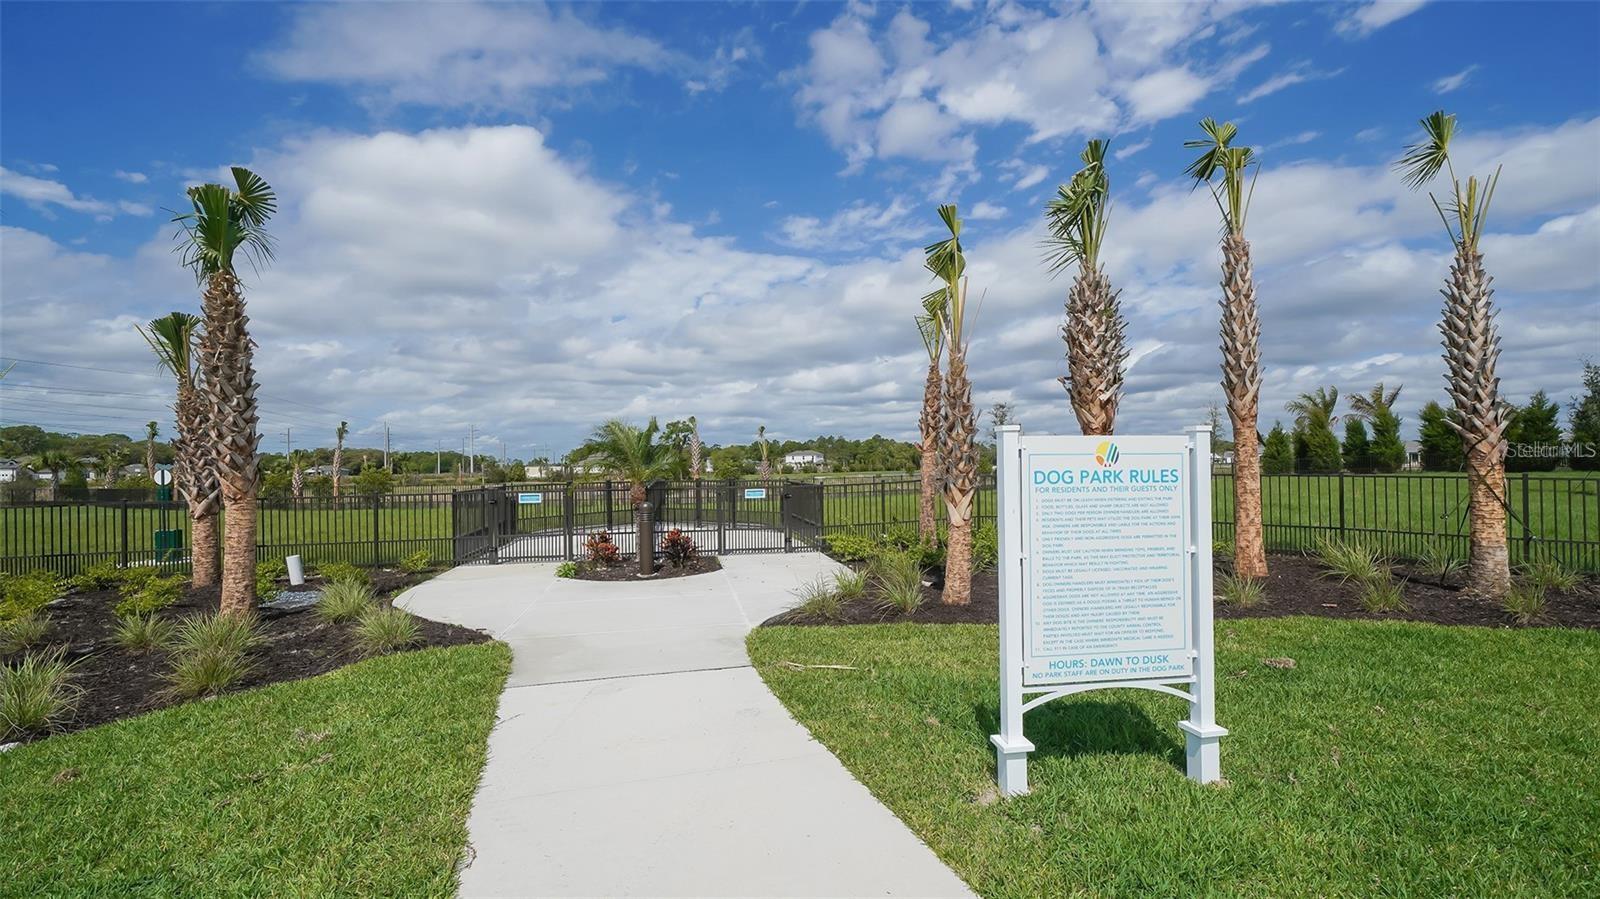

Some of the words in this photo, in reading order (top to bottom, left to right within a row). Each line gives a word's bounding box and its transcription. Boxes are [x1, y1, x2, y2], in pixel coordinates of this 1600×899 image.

[1034, 470, 1074, 484] DOG
[1080, 470, 1124, 484] PARK
[1130, 469, 1178, 483] RULES
[1049, 659, 1087, 669] HOURS:
[1090, 657, 1122, 668] DAWN
[1126, 656, 1140, 665] TO
[1142, 655, 1168, 664] DUSK
